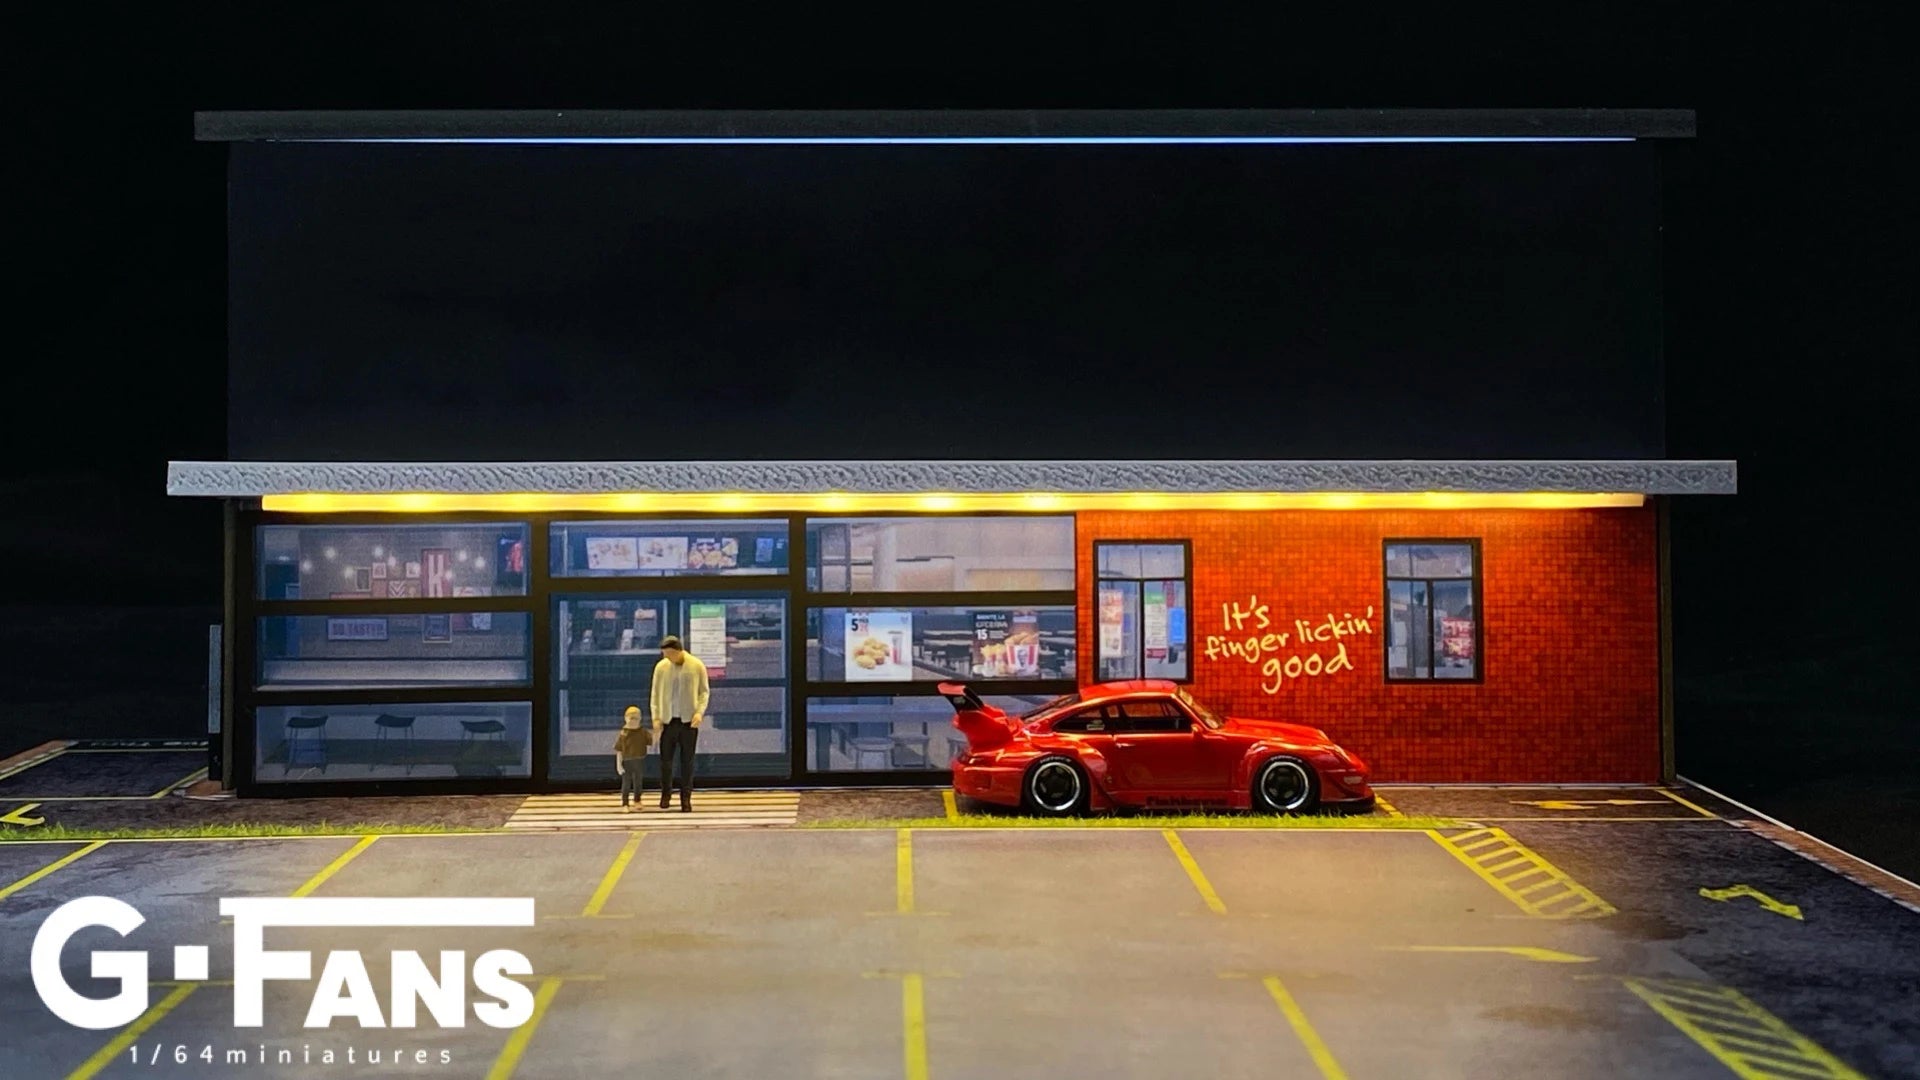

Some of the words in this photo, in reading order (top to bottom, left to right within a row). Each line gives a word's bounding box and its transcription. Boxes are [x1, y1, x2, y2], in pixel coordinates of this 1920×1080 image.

[851, 618, 859, 632] 5
[1222, 594, 1271, 631] It's
[975, 628, 988, 641] 15
[1204, 633, 1290, 664] finger
[1295, 605, 1374, 644] lickin'
[1261, 642, 1354, 694] good
